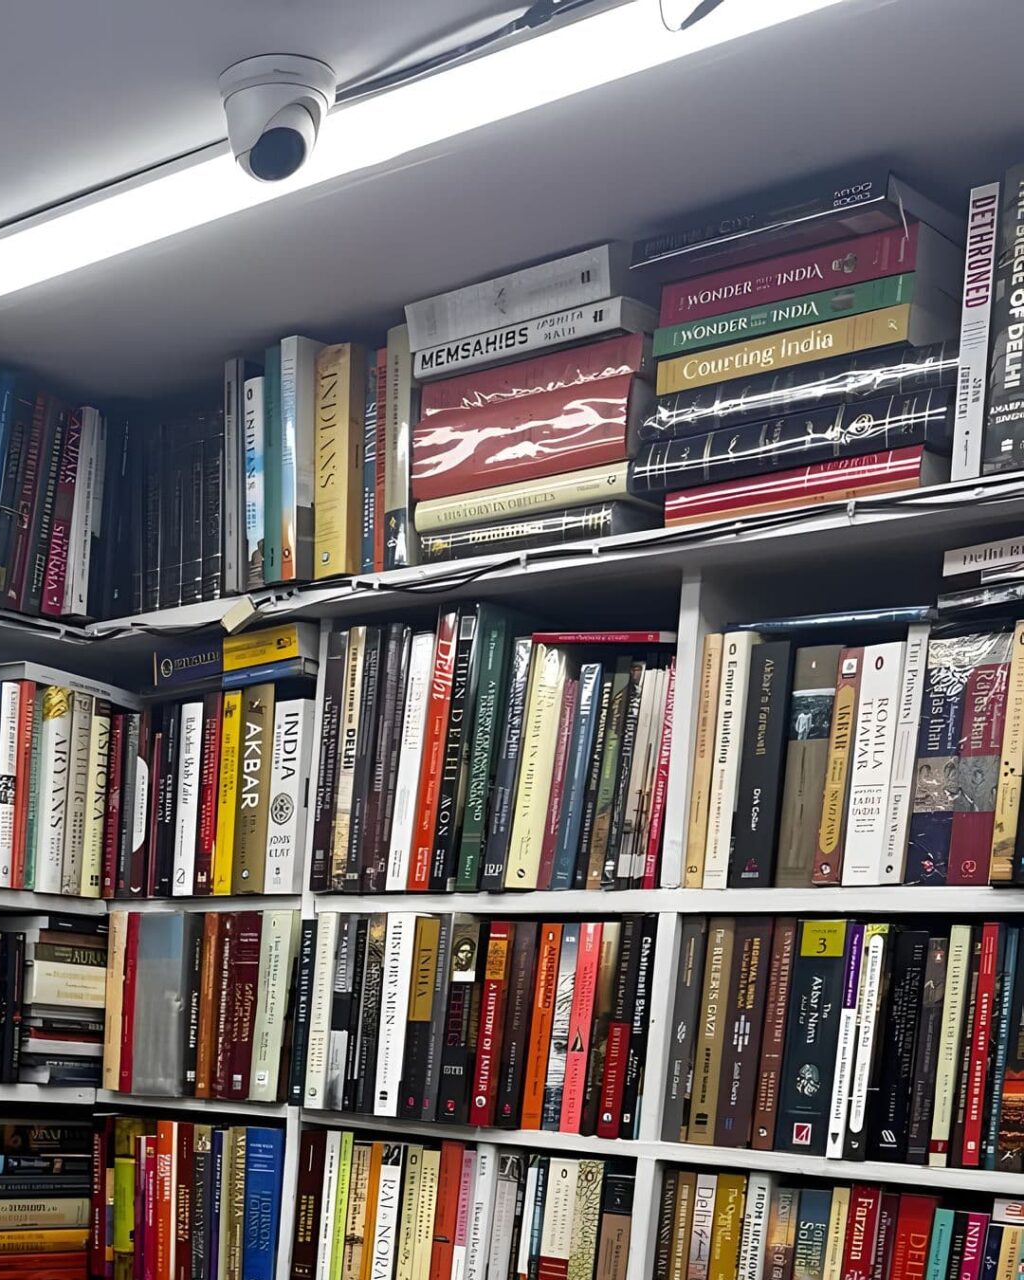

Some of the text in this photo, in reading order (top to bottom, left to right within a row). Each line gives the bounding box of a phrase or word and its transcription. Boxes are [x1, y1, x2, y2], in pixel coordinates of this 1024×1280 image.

[965, 194, 997, 309] DETHRONED
[687, 263, 824, 310] WONDER INDIA
[421, 326, 530, 371] MEMSAHIBS
[680, 301, 819, 344] WONDER INDIA
[683, 330, 834, 381] Courting India
[1003, 322, 1023, 390] DELHI
[432, 638, 454, 701] Delhi
[718, 659, 738, 765] Empire Building
[856, 698, 874, 771] THAPAR
[872, 697, 890, 770] ROMILA
[93, 721, 110, 822] ASHOKA
[240, 721, 262, 810] AKBAR
[280, 712, 300, 781] INDIA
[343, 727, 356, 771] DELHI
[443, 707, 464, 783] DELHI
[416, 947, 432, 998] INDIA
[815, 937, 827, 955] 3
[693, 1186, 715, 1229] Delhi
[755, 1186, 767, 1215] FROM
[850, 1197, 874, 1261] Farzana
[747, 1221, 761, 1280] LUCKNOW
[963, 1220, 981, 1263] INDIA
